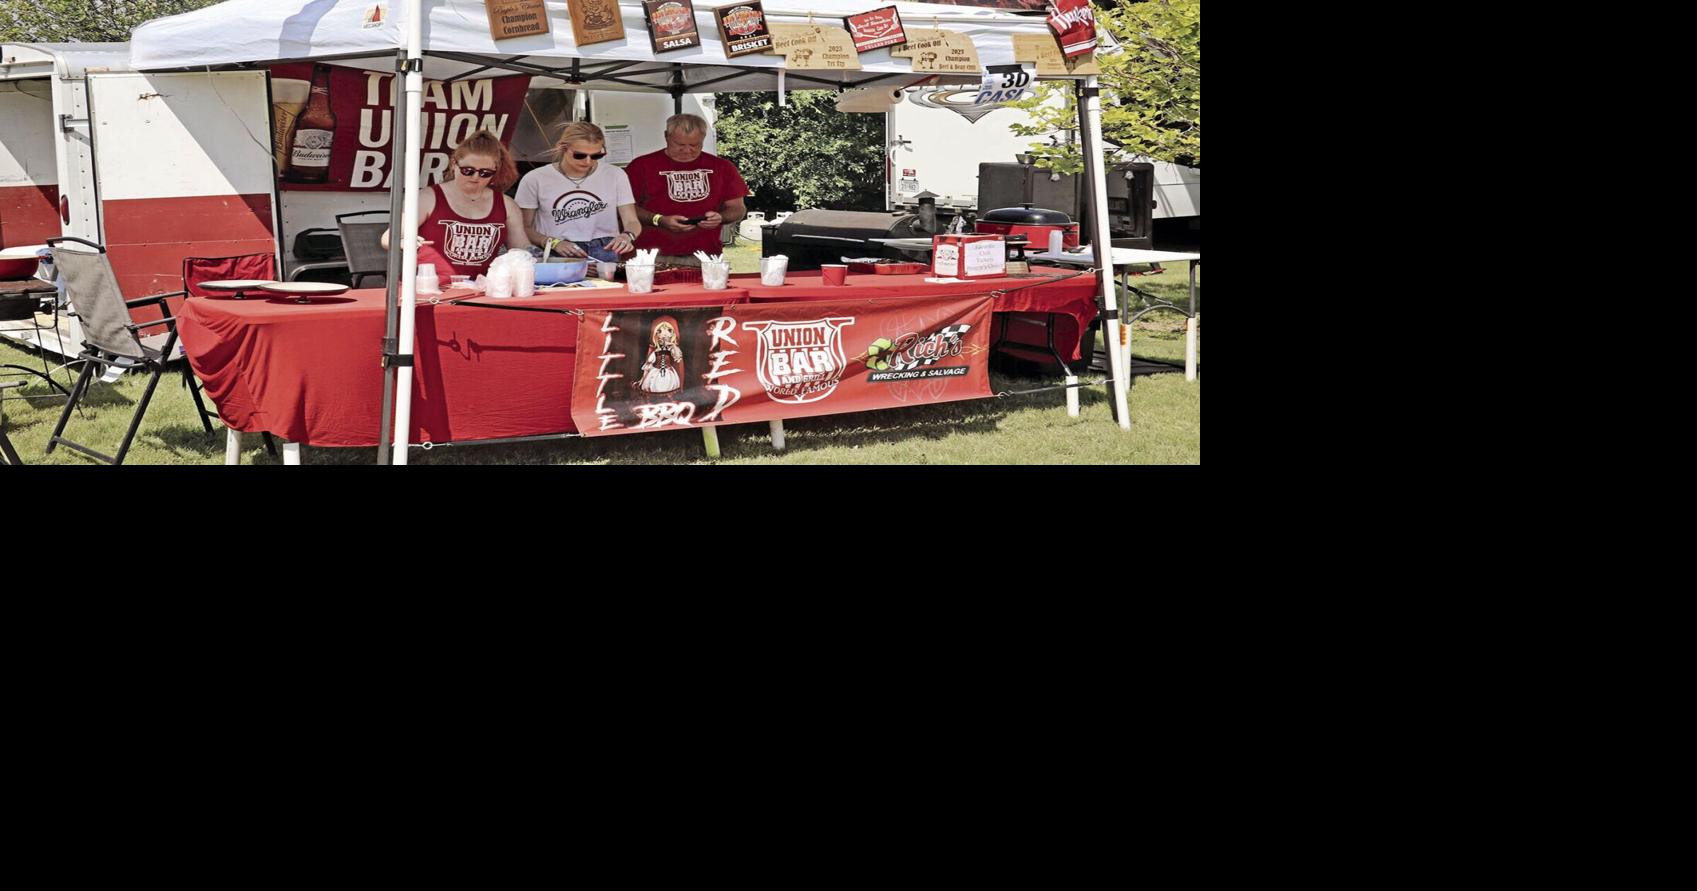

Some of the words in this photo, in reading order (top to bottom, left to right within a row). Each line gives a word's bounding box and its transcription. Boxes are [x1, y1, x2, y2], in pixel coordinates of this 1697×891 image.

[502, 13, 538, 24] Champion
[504, 22, 540, 34] Cornbread
[663, 37, 692, 49] SALSA
[731, 38, 769, 52] BRISKET
[902, 43, 917, 52] Beef
[917, 41, 932, 50] Cook
[933, 39, 942, 47] Off
[362, 70, 493, 111] TAM
[358, 108, 509, 150] UION
[673, 180, 704, 192] BAR
[674, 173, 700, 181] UNION
[551, 200, 608, 223] Wrangler
[456, 225, 491, 235] UNION
[451, 235, 492, 254] BAR
[771, 326, 826, 347] UNION
[887, 332, 964, 369] Rich's
[594, 311, 626, 431] LITTLE
[698, 316, 744, 422] RED
[770, 350, 834, 377] BAR
[872, 371, 919, 380] WRECKING
[928, 367, 967, 376] SALVAGE
[766, 384, 798, 395] WORLD
[801, 377, 840, 395] FAMOUS
[628, 401, 696, 431] BBQ
